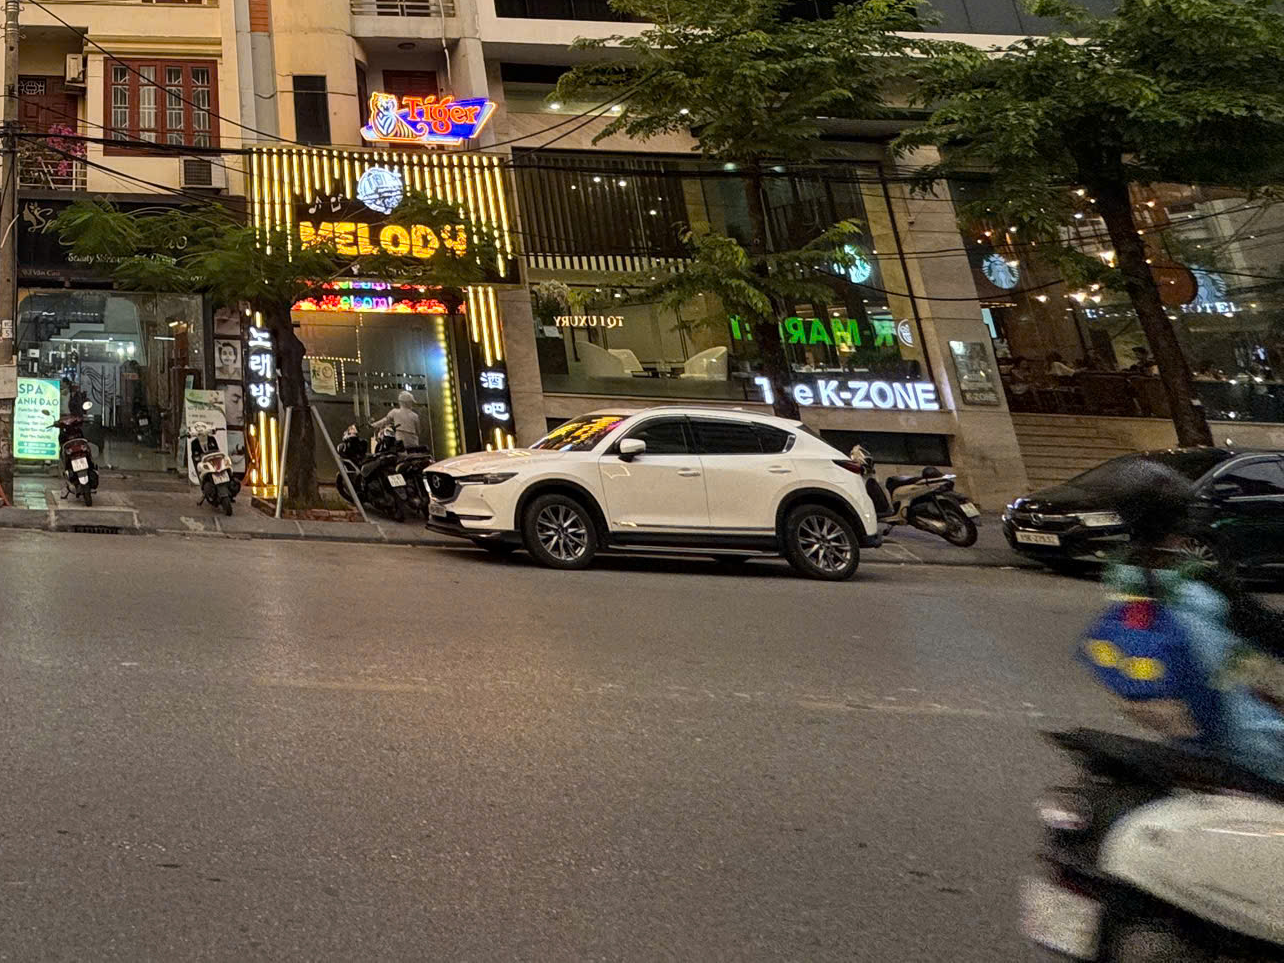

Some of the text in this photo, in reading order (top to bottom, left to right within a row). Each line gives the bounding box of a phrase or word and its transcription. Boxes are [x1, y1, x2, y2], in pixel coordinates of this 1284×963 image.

[402, 95, 481, 135] Tiger
[17, 397, 37, 406] ANH
[18, 383, 44, 395] SPA
[480, 371, 510, 421] 酒吧
[754, 376, 940, 411] Te K-ZONE
